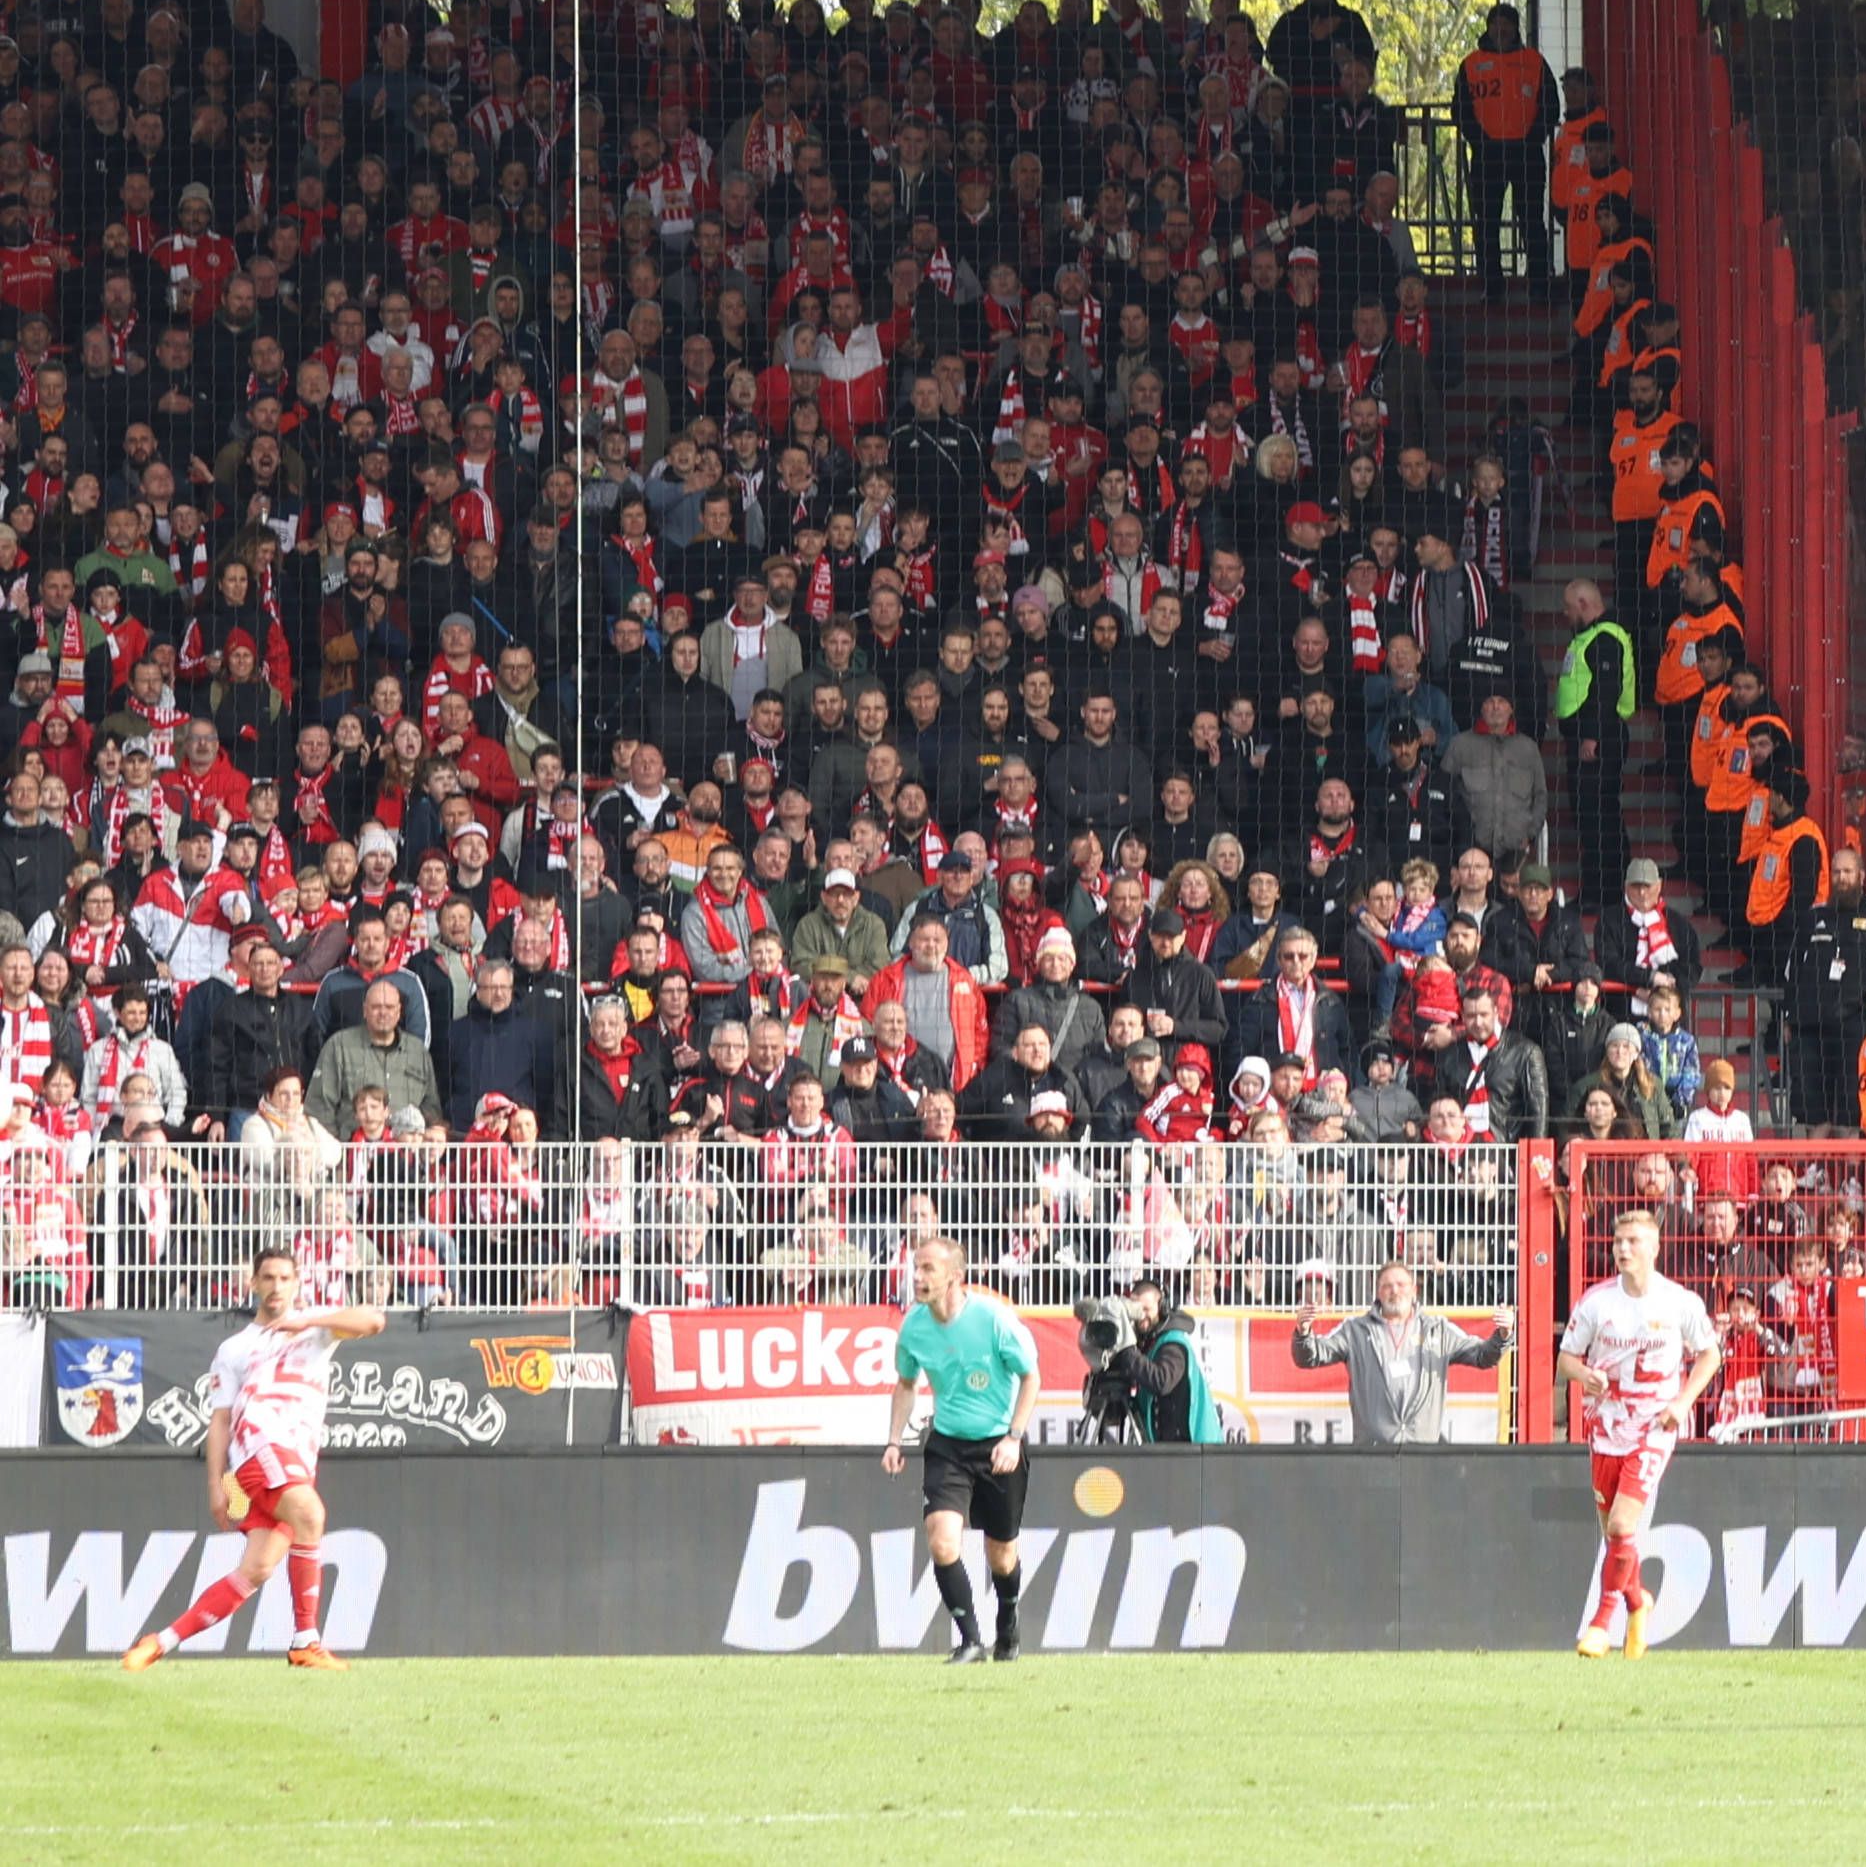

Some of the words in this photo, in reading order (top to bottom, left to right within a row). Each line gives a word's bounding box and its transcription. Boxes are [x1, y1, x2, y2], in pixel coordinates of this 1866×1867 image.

[557, 1355, 617, 1383] UNION
[653, 1312, 931, 1392] Lucka
[723, 1466, 1247, 1651] bwin
